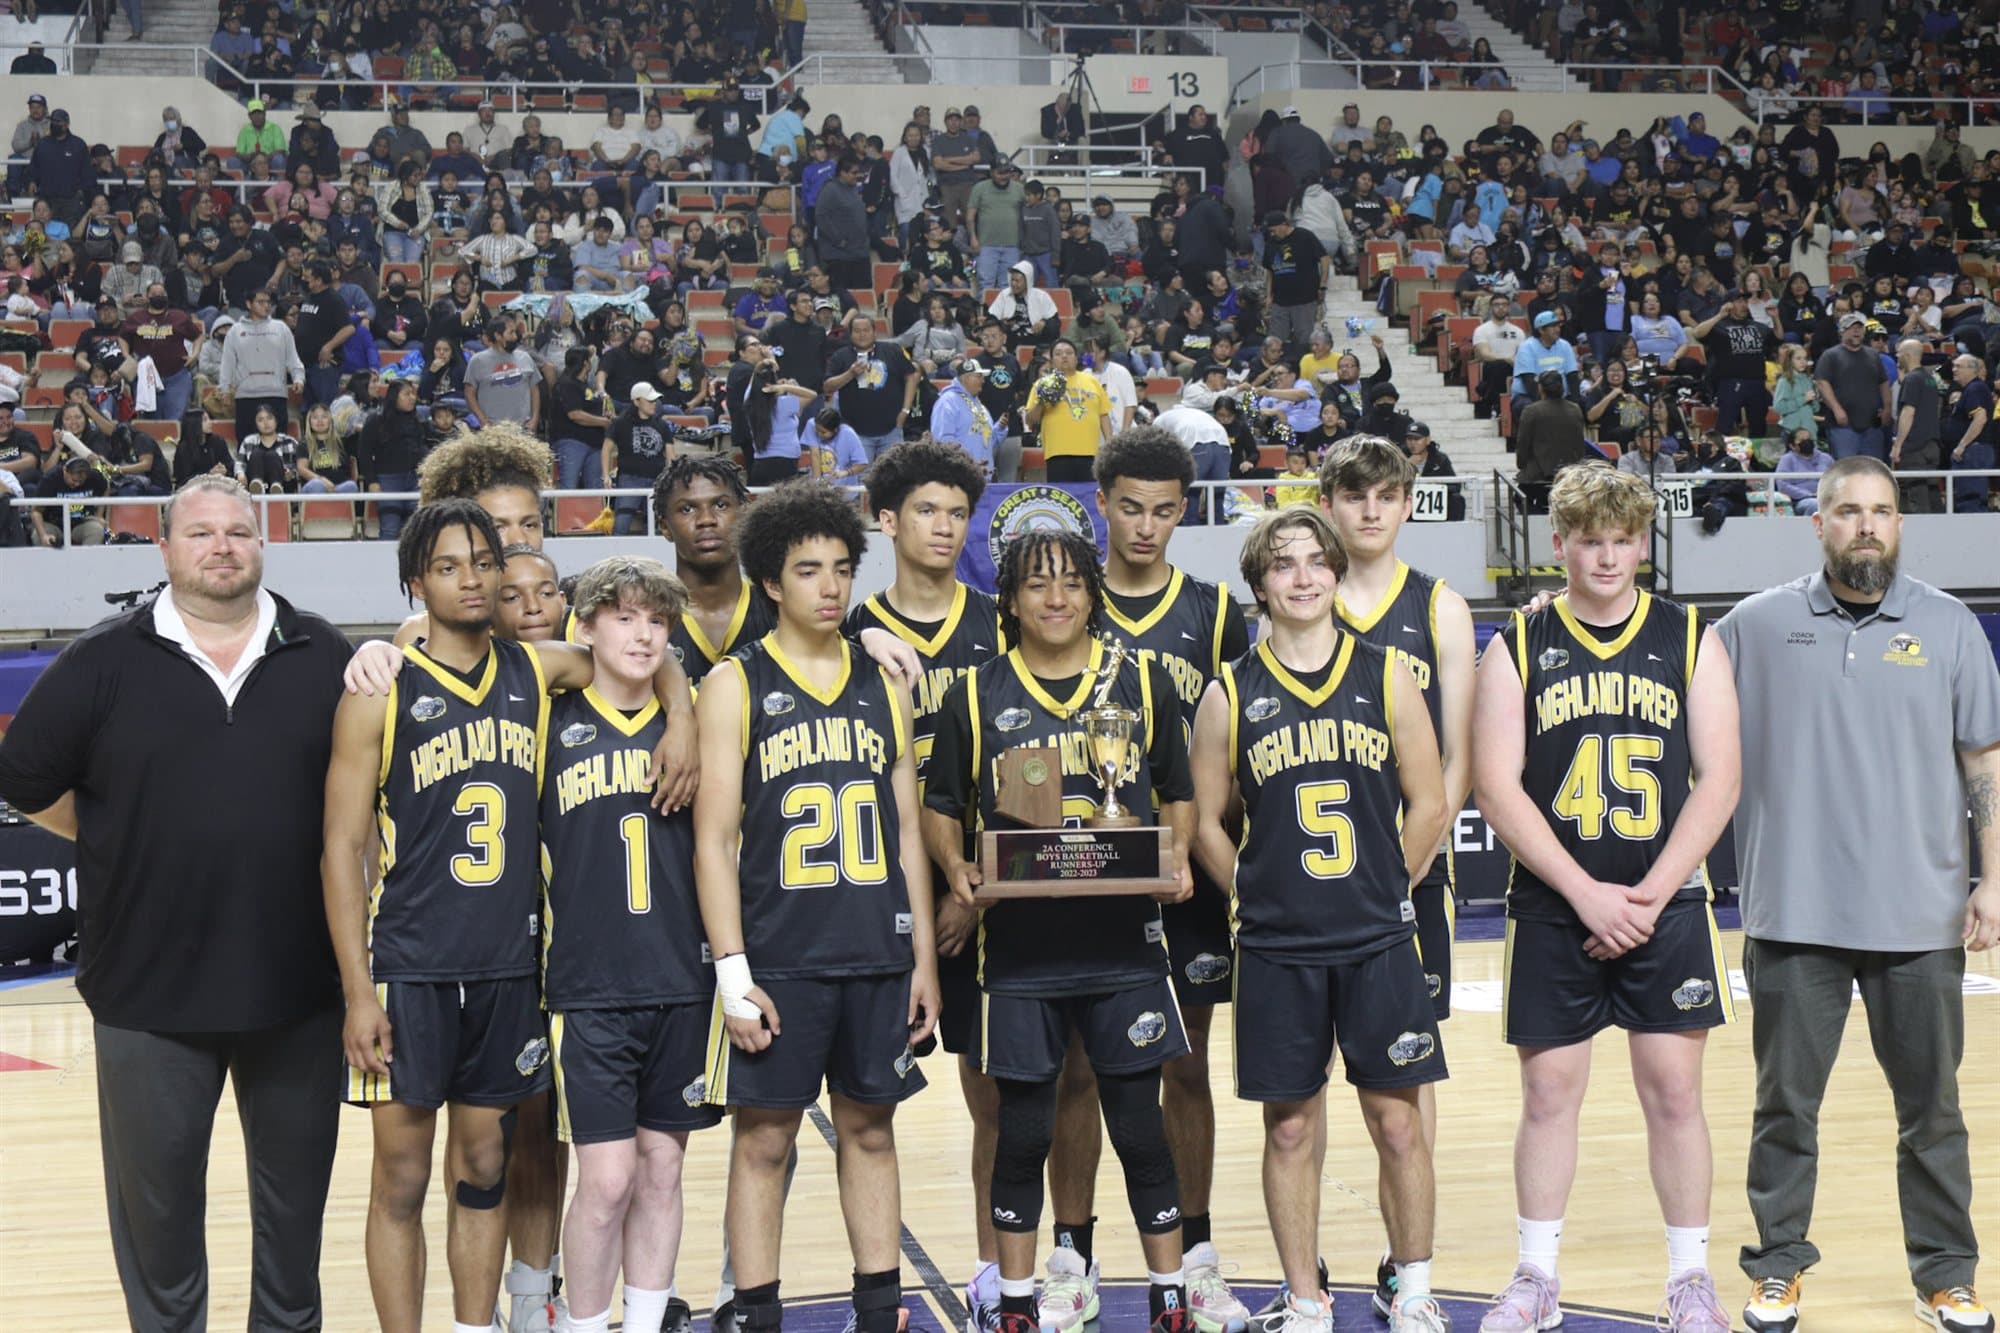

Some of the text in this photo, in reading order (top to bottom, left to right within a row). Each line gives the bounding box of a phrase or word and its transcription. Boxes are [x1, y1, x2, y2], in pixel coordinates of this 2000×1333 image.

[1167, 72, 1200, 97] 13
[998, 487, 1083, 518] GREAT SEAL
[1416, 490, 1444, 514] 214
[1662, 488, 1689, 512] 215
[1535, 672, 1679, 736] HIGHLAND PREP
[410, 716, 496, 793] HIGHLAND
[556, 749, 653, 816] HIGHLAND
[759, 717, 852, 783] HIGHLAND
[1247, 719, 1389, 786] HIGHLAND PREP
[1552, 734, 1663, 840] 45
[450, 782, 506, 887] 3
[780, 780, 888, 890] 20
[1036, 852, 1121, 861] BOYS BASKETBALL
[1042, 843, 1114, 853] 2A CONFERENCE
[1295, 779, 1357, 880] 5
[619, 812, 651, 914] 1
[1050, 861, 1107, 869] RUNNERS-UP
[1060, 869, 1098, 878] 2022-2023
